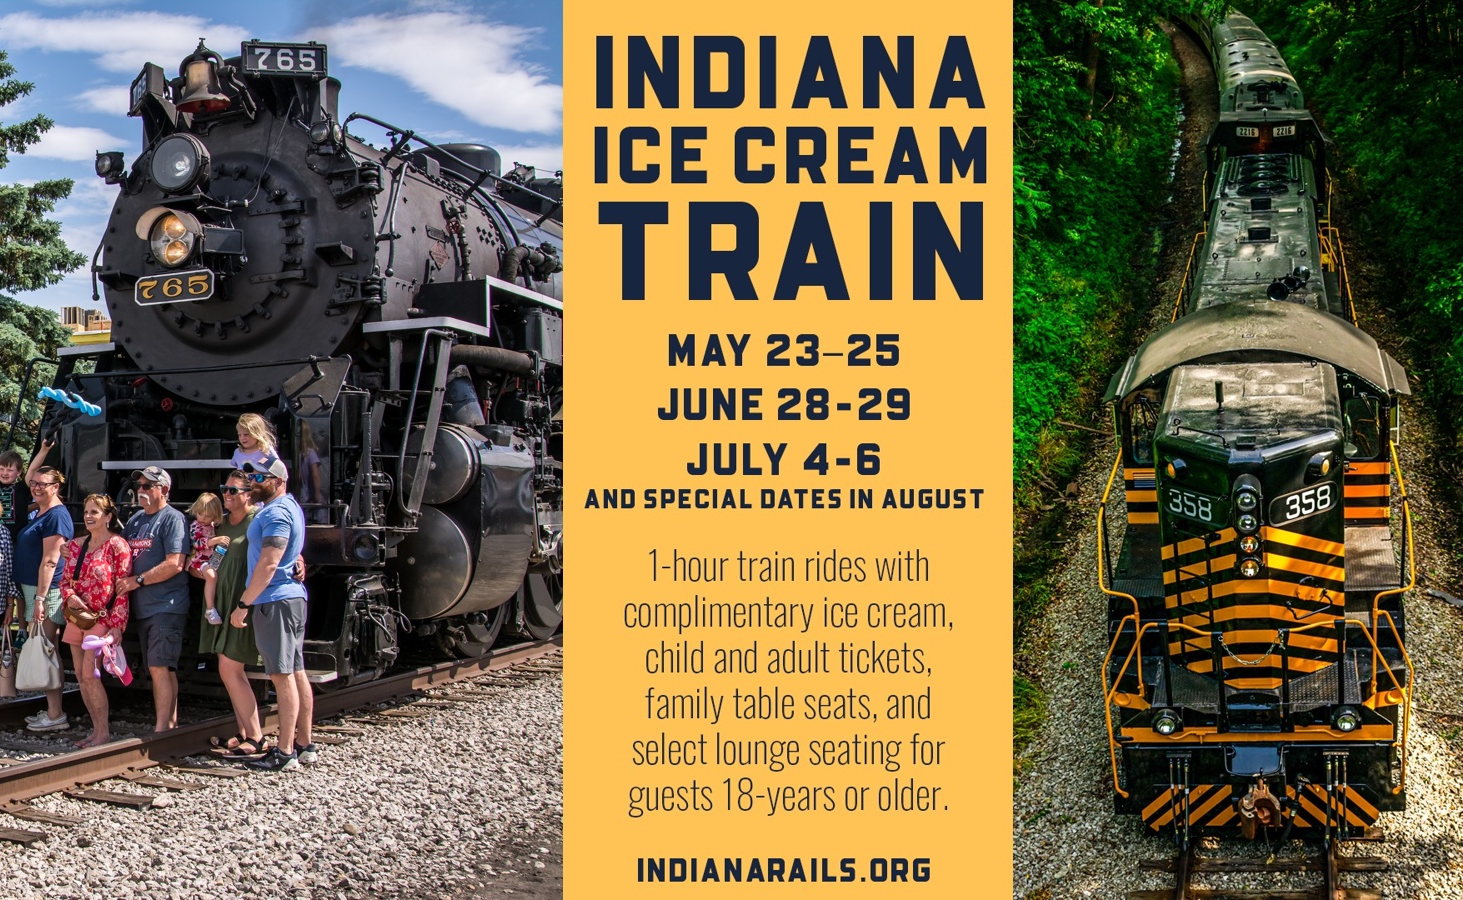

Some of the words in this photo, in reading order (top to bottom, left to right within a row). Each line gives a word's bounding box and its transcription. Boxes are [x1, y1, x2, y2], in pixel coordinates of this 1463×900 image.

[254, 48, 316, 71] 765
[1239, 127, 1256, 136] 2216
[1277, 126, 1292, 135] 2216
[138, 274, 209, 299] 765
[1169, 488, 1212, 521] 358
[1285, 485, 1331, 520] 358
